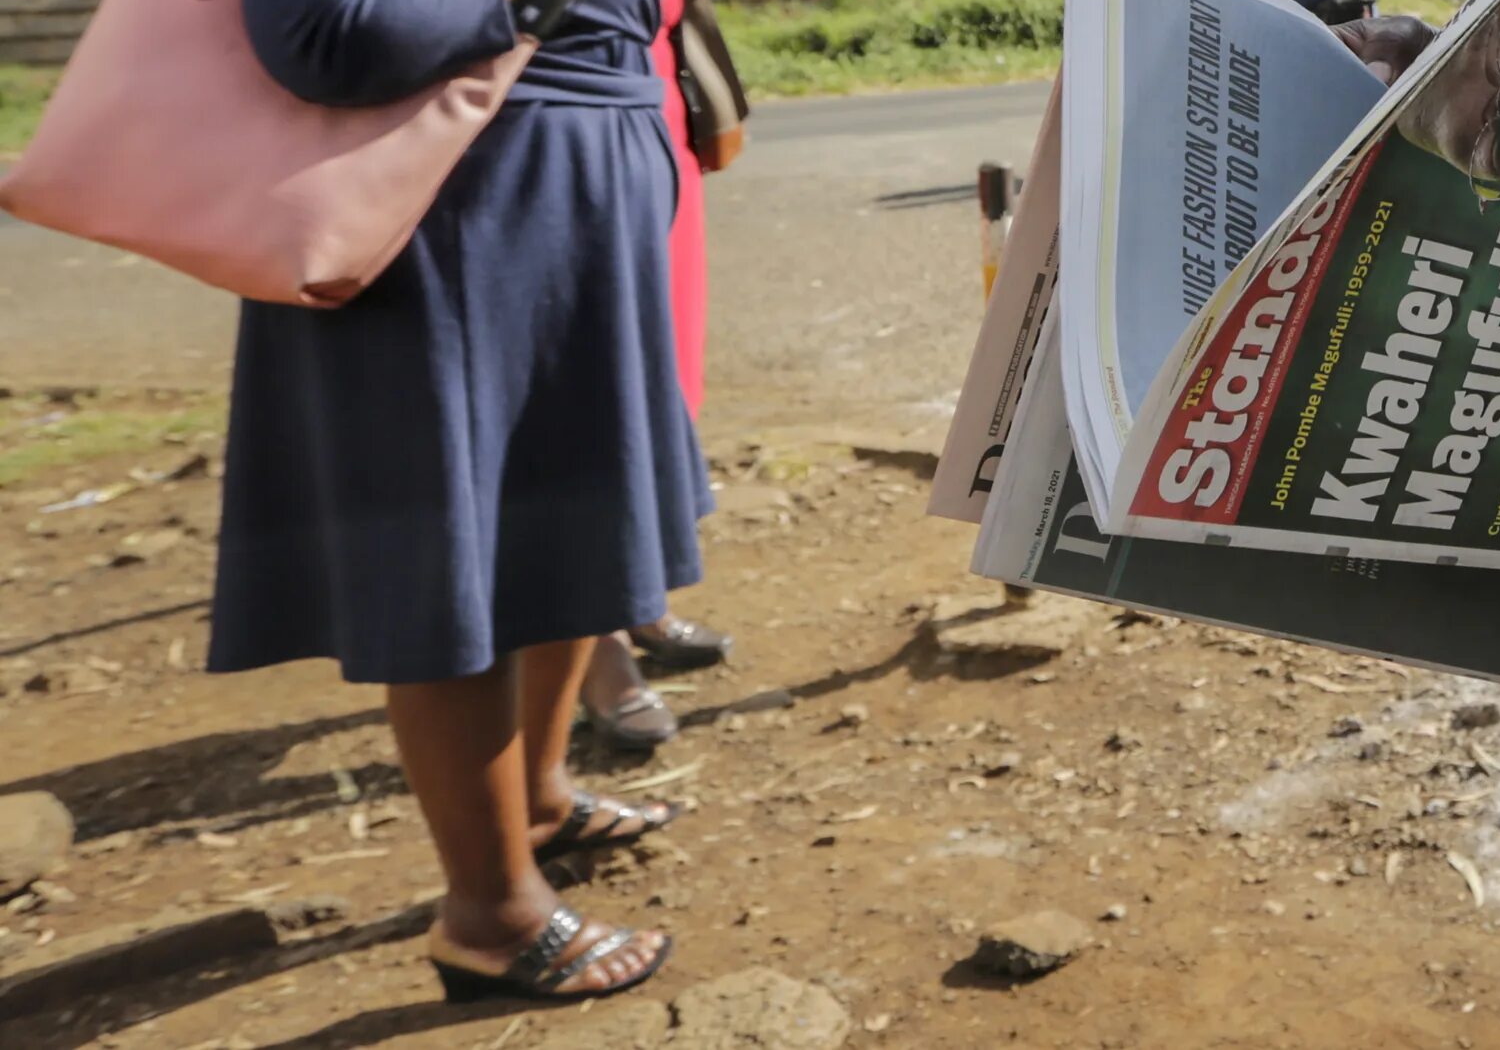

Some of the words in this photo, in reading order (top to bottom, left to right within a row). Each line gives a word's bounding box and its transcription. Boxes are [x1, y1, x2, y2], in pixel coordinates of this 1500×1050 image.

[1228, 44, 1260, 121] MADE
[1226, 119, 1259, 157] BE
[1182, 132, 1217, 246] FASHION
[1226, 158, 1258, 191] TO
[1009, 327, 1028, 370] PUBLICATION
[1270, 464, 1296, 510] John
[1286, 394, 1320, 460] Pombe
[1310, 302, 1354, 390] Magufuli:
[1345, 201, 1392, 296] 1959-2021
[1181, 360, 1213, 409] The
[1310, 235, 1472, 521] Kwaheri
[1047, 469, 1060, 492] 2021
[1224, 476, 1242, 513] THURSDAY,
[1238, 443, 1252, 475] MARCH
[1253, 411, 1264, 430] 2021
[1034, 508, 1049, 537] March
[1043, 494, 1055, 506] 18,
